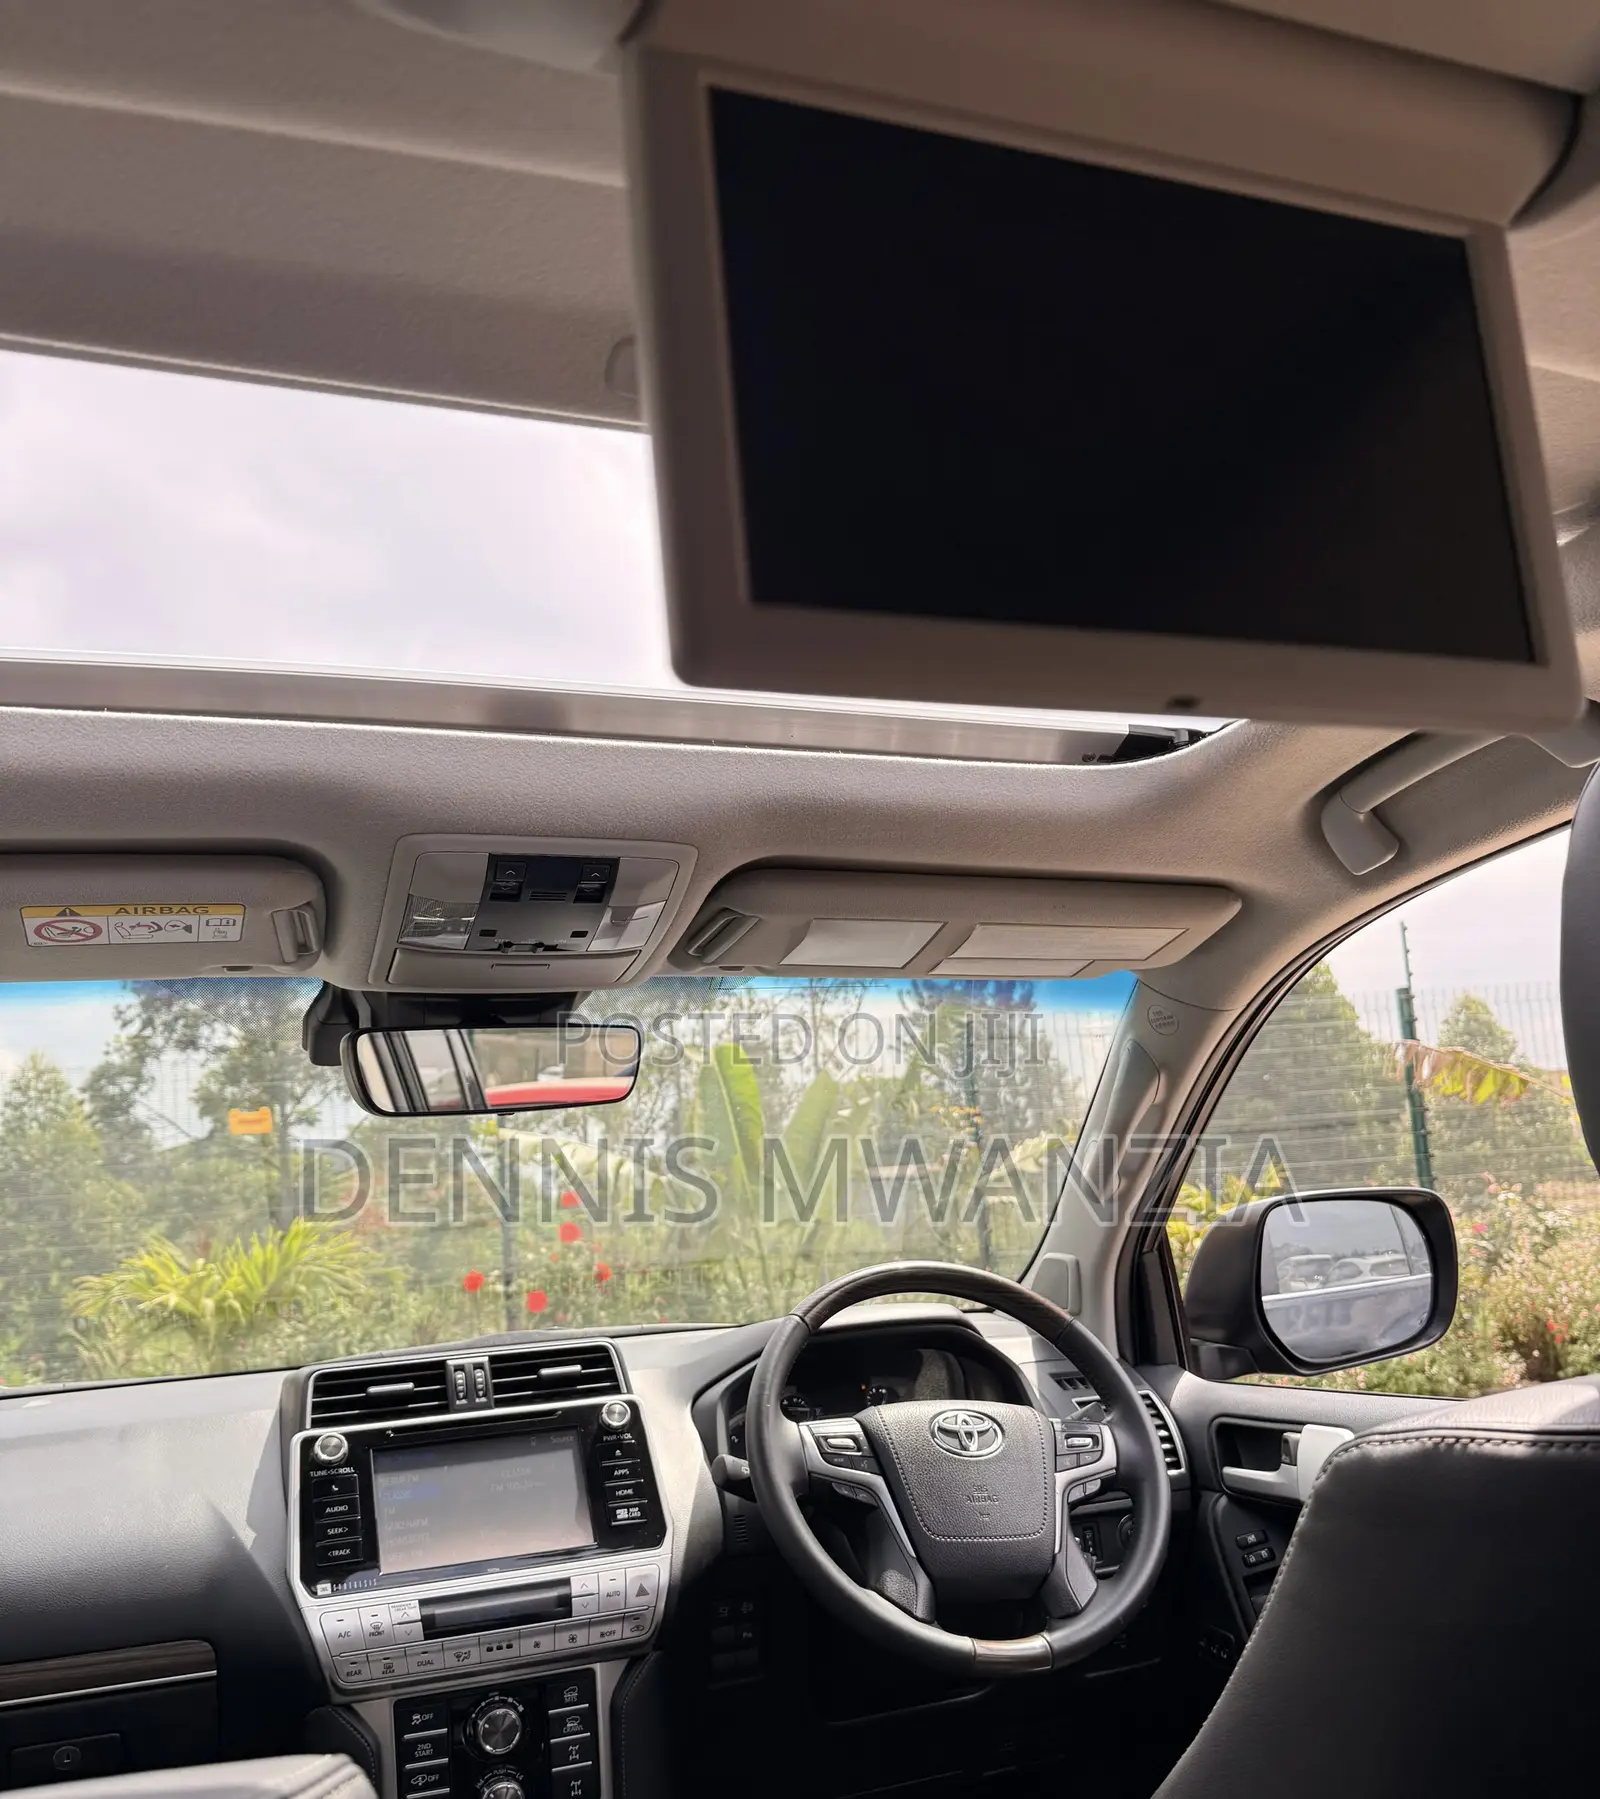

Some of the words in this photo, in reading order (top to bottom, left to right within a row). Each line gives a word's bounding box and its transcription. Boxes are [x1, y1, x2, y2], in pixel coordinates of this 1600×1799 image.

[115, 906, 210, 915] AIRBAG
[613, 1468, 629, 1476] APPS
[615, 1488, 634, 1496] HOME
[966, 1495, 999, 1503] AIRBAG
[325, 1505, 348, 1513] AUDIO
[606, 1590, 621, 1598] AUTO
[338, 1631, 352, 1639] A/C
[605, 1629, 617, 1638] OFF
[417, 1659, 435, 1667] DUAL
[346, 1669, 363, 1677] REAR
[422, 1713, 434, 1721] OFF
[417, 1743, 432, 1751] 2ND
[414, 1749, 434, 1757] START
[427, 1774, 440, 1783] OFF
